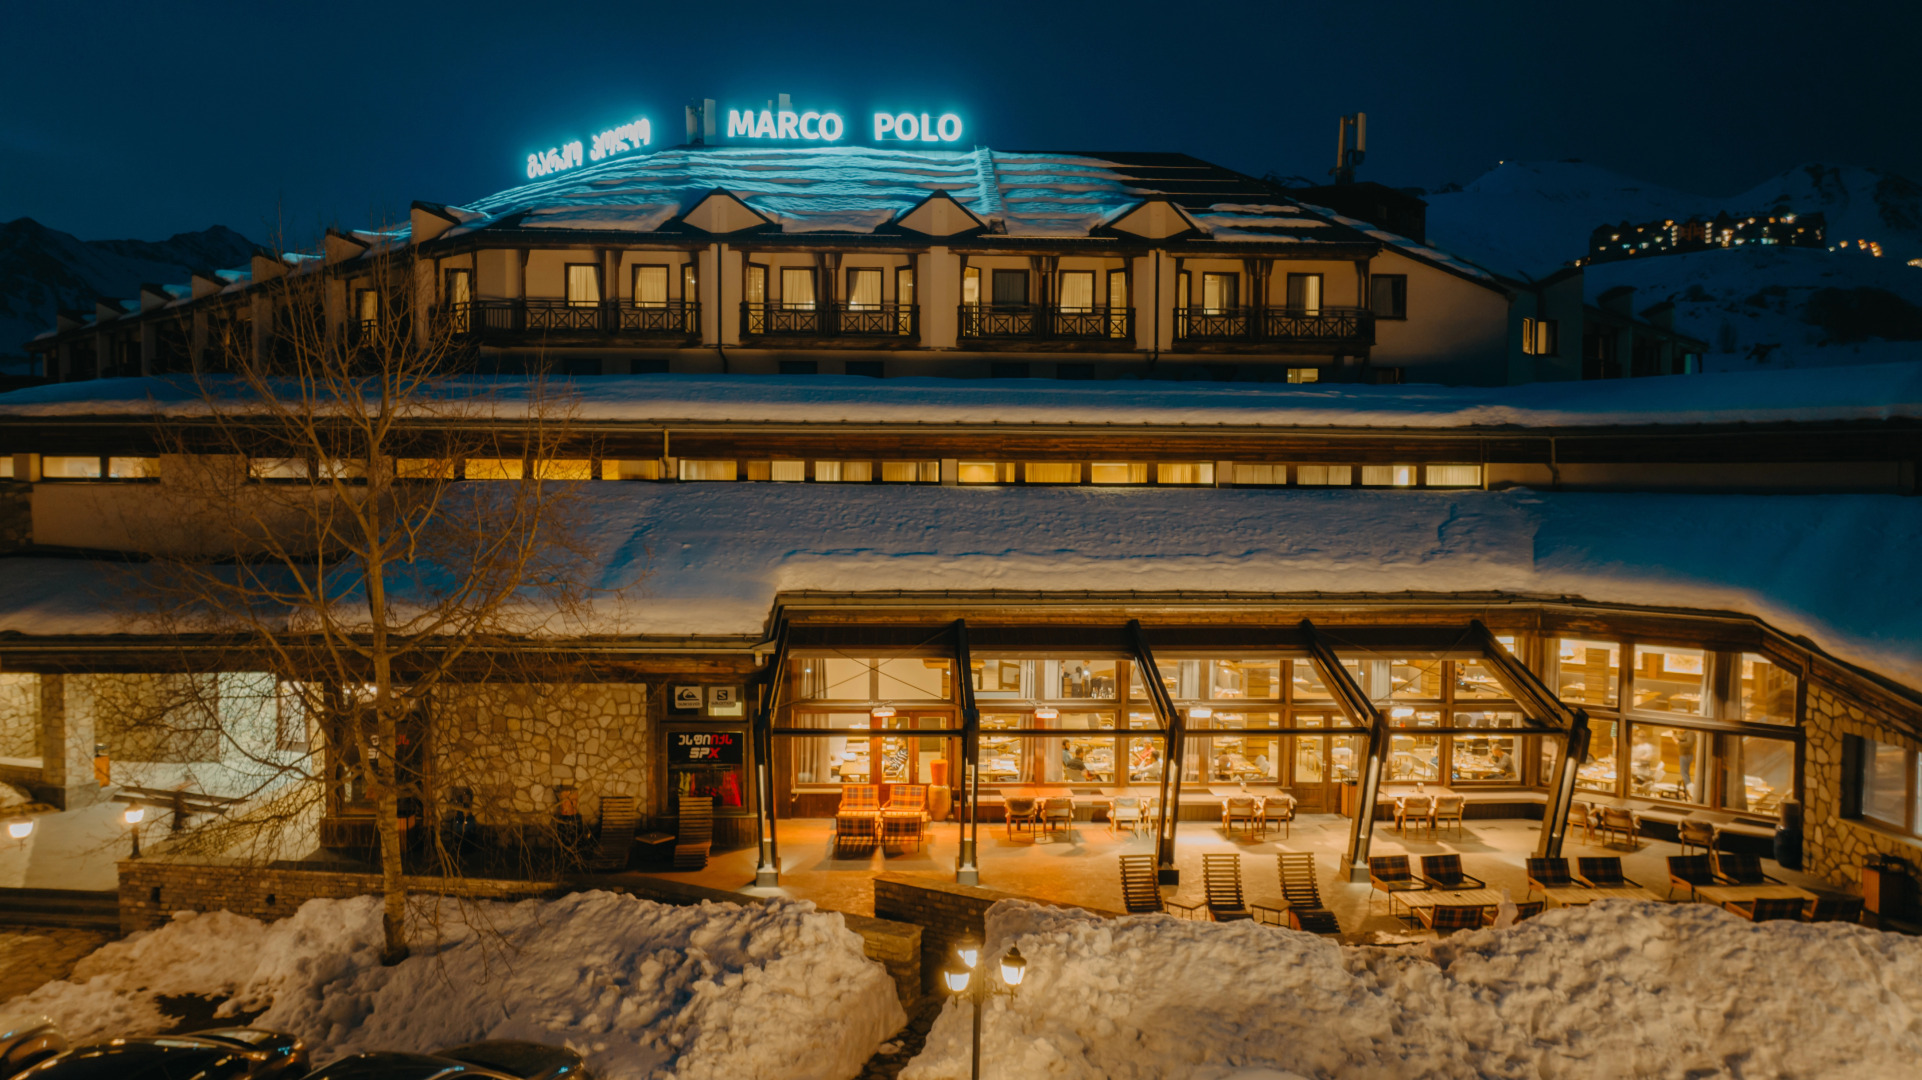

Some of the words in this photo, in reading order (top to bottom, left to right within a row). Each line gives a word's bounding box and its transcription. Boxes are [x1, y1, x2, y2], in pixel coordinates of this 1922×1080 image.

[727, 109, 844, 141] MARCO
[874, 112, 963, 142] POLO
[689, 747, 721, 759] SPX
